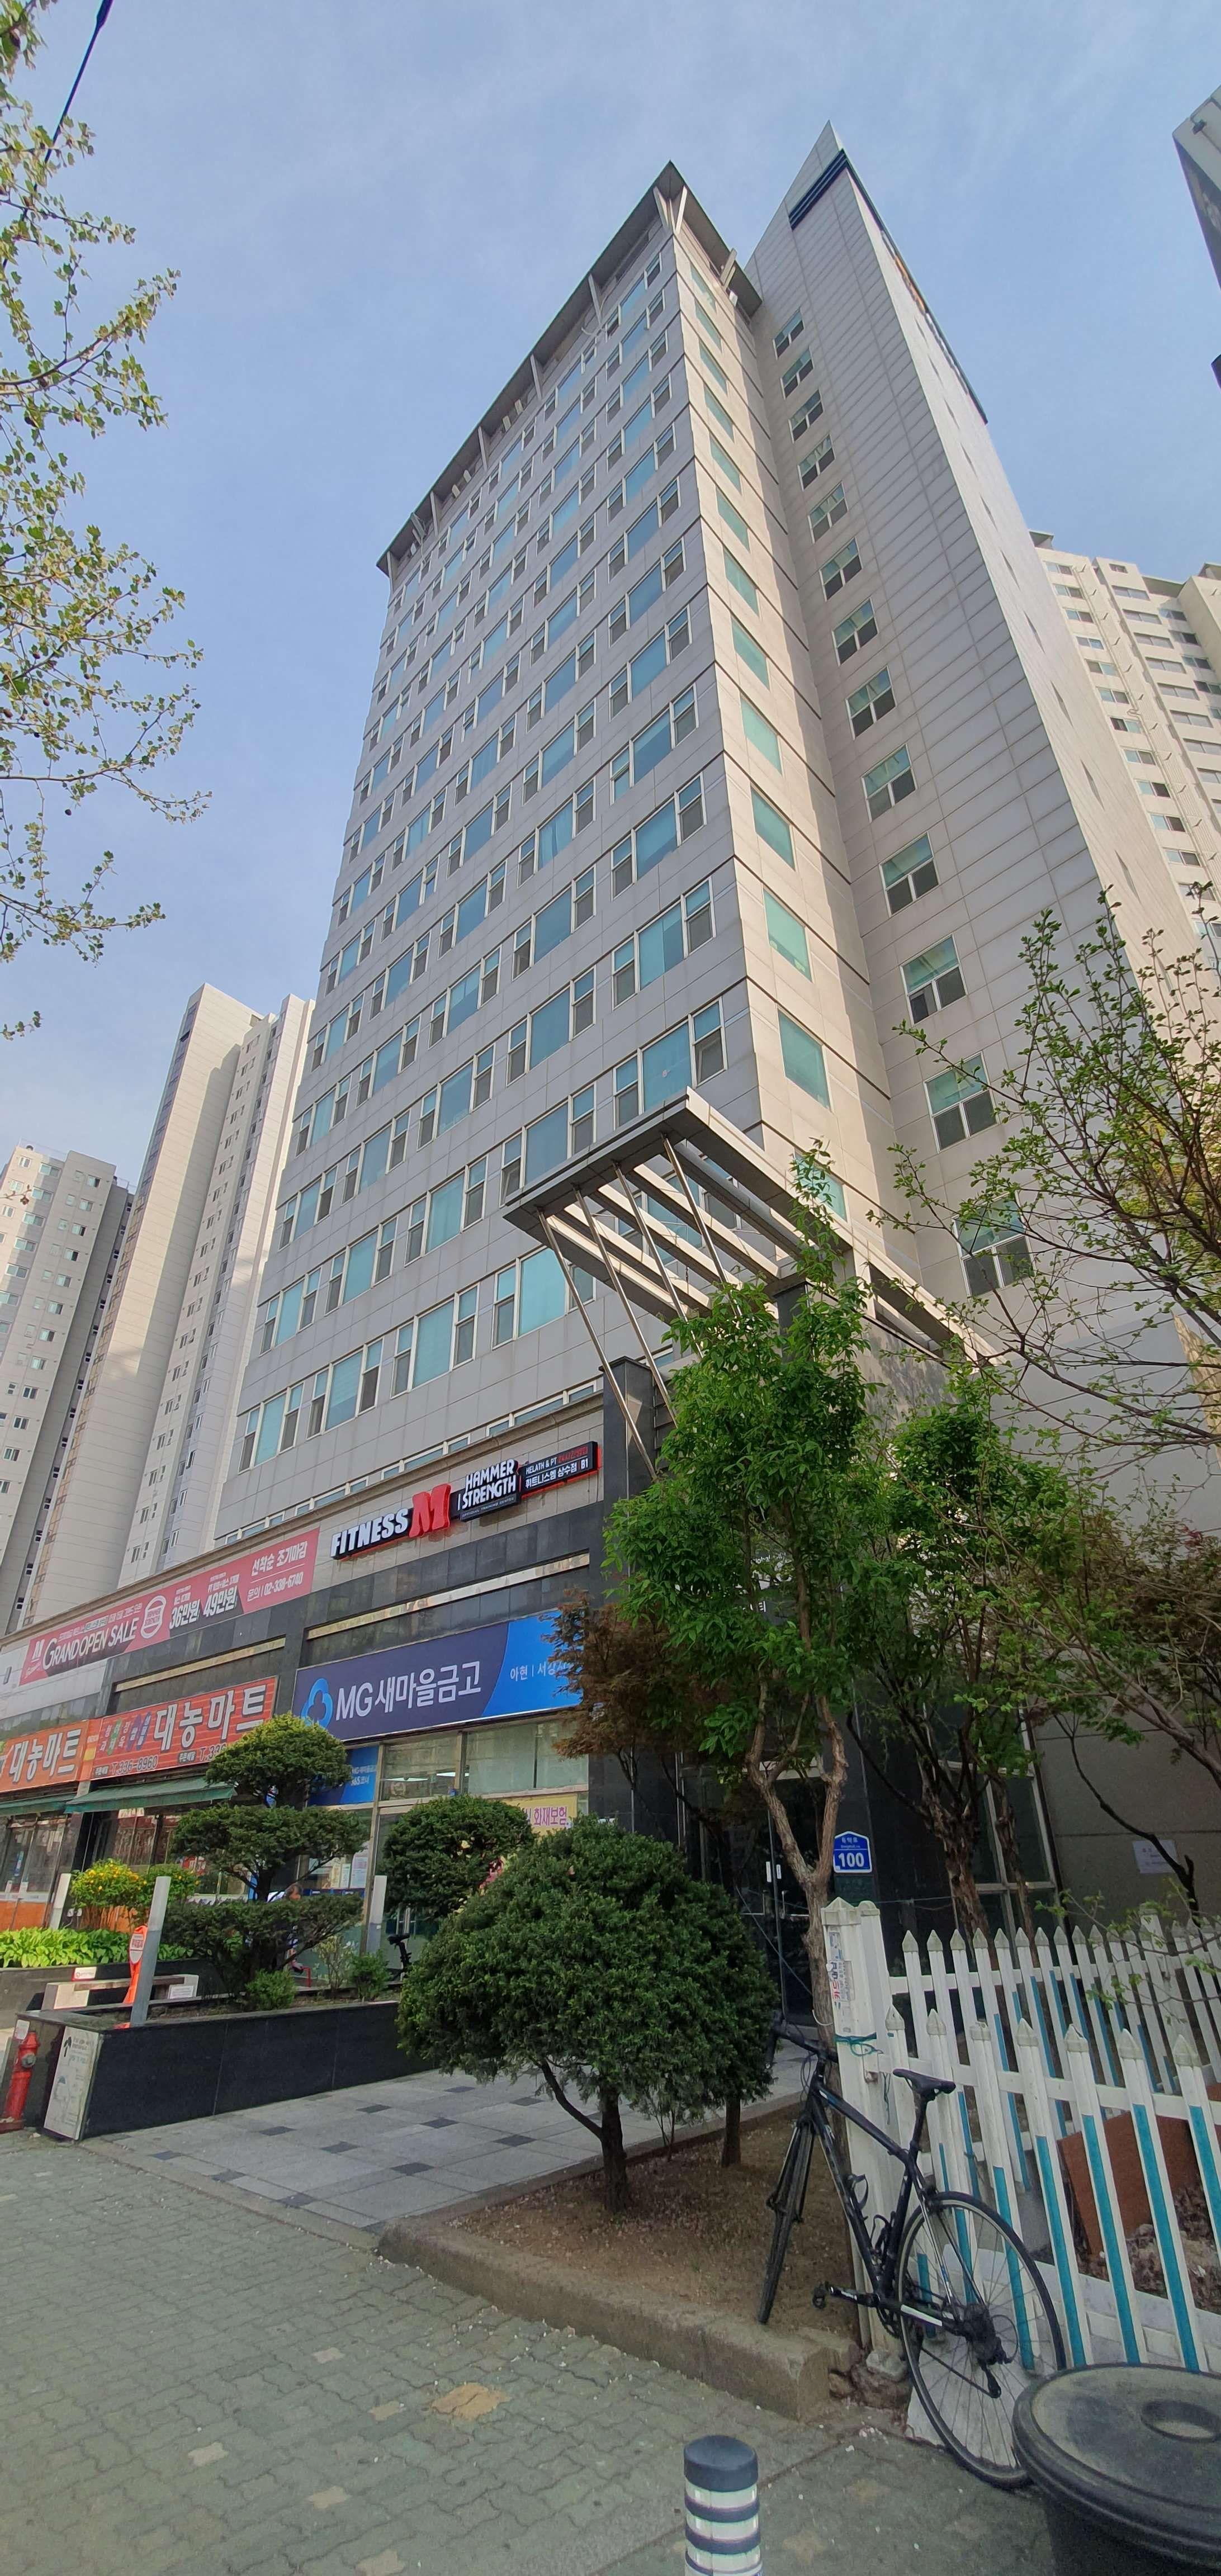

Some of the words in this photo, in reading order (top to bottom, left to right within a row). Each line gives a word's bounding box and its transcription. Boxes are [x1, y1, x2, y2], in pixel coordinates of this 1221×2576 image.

[465, 1459, 515, 1491] HAMMER
[524, 1470, 556, 1488] 휘트니스엠
[557, 1462, 577, 1478] 상수점
[581, 1458, 589, 1469] B1
[546, 1460, 550, 1468] &
[551, 1457, 557, 1466] PT
[462, 1475, 516, 1509] STRENGTH
[330, 1508, 410, 1557] FITNESS
[409, 1484, 451, 1538] M
[252, 1552, 275, 1577] 선착순
[277, 1540, 308, 1568] 조기마감
[247, 1586, 260, 1602] 문의
[108, 1617, 140, 1647] SALE
[510, 1664, 528, 1682] 아현
[154, 1684, 267, 1751] 대농마트
[9, 1729, 81, 1783] 대농마트
[534, 1806, 567, 1826] 화재보험
[838, 1852, 865, 1867] 100
